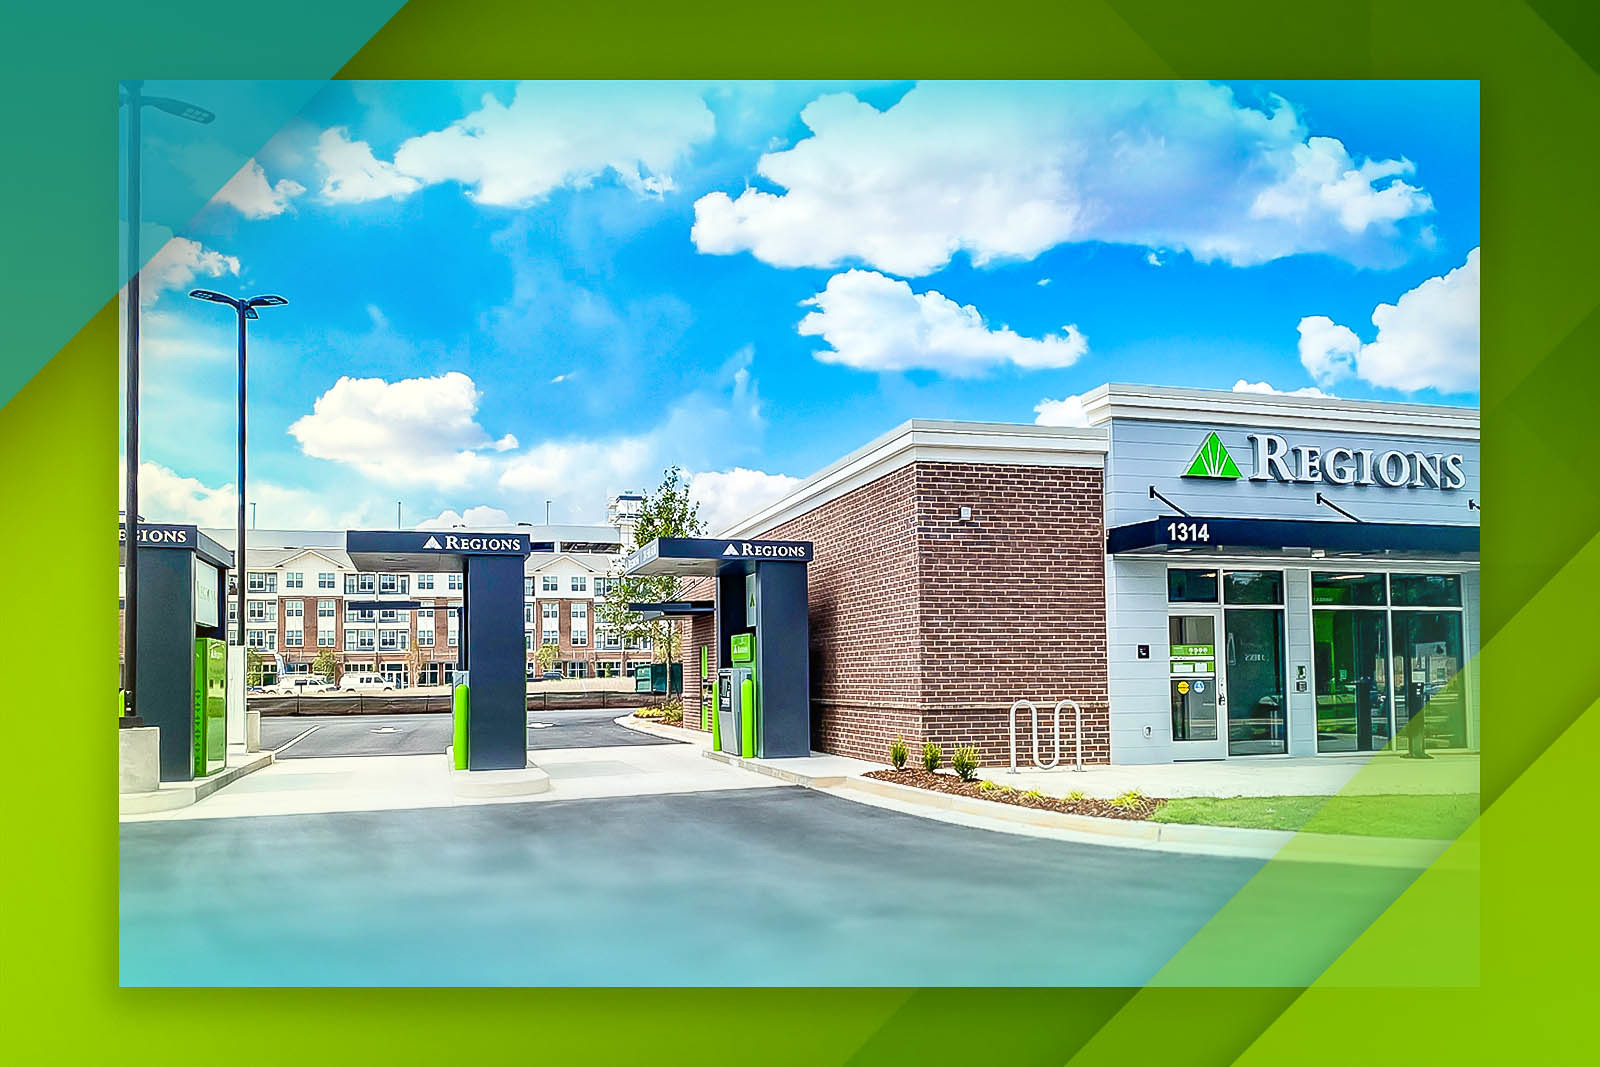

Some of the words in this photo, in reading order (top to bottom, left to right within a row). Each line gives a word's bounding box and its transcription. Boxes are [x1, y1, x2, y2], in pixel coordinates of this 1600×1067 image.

[1249, 433, 1466, 489] REGIONS
[1167, 522, 1209, 542] 1314
[445, 535, 520, 550] REGIONS
[741, 543, 805, 557] REGIONS
